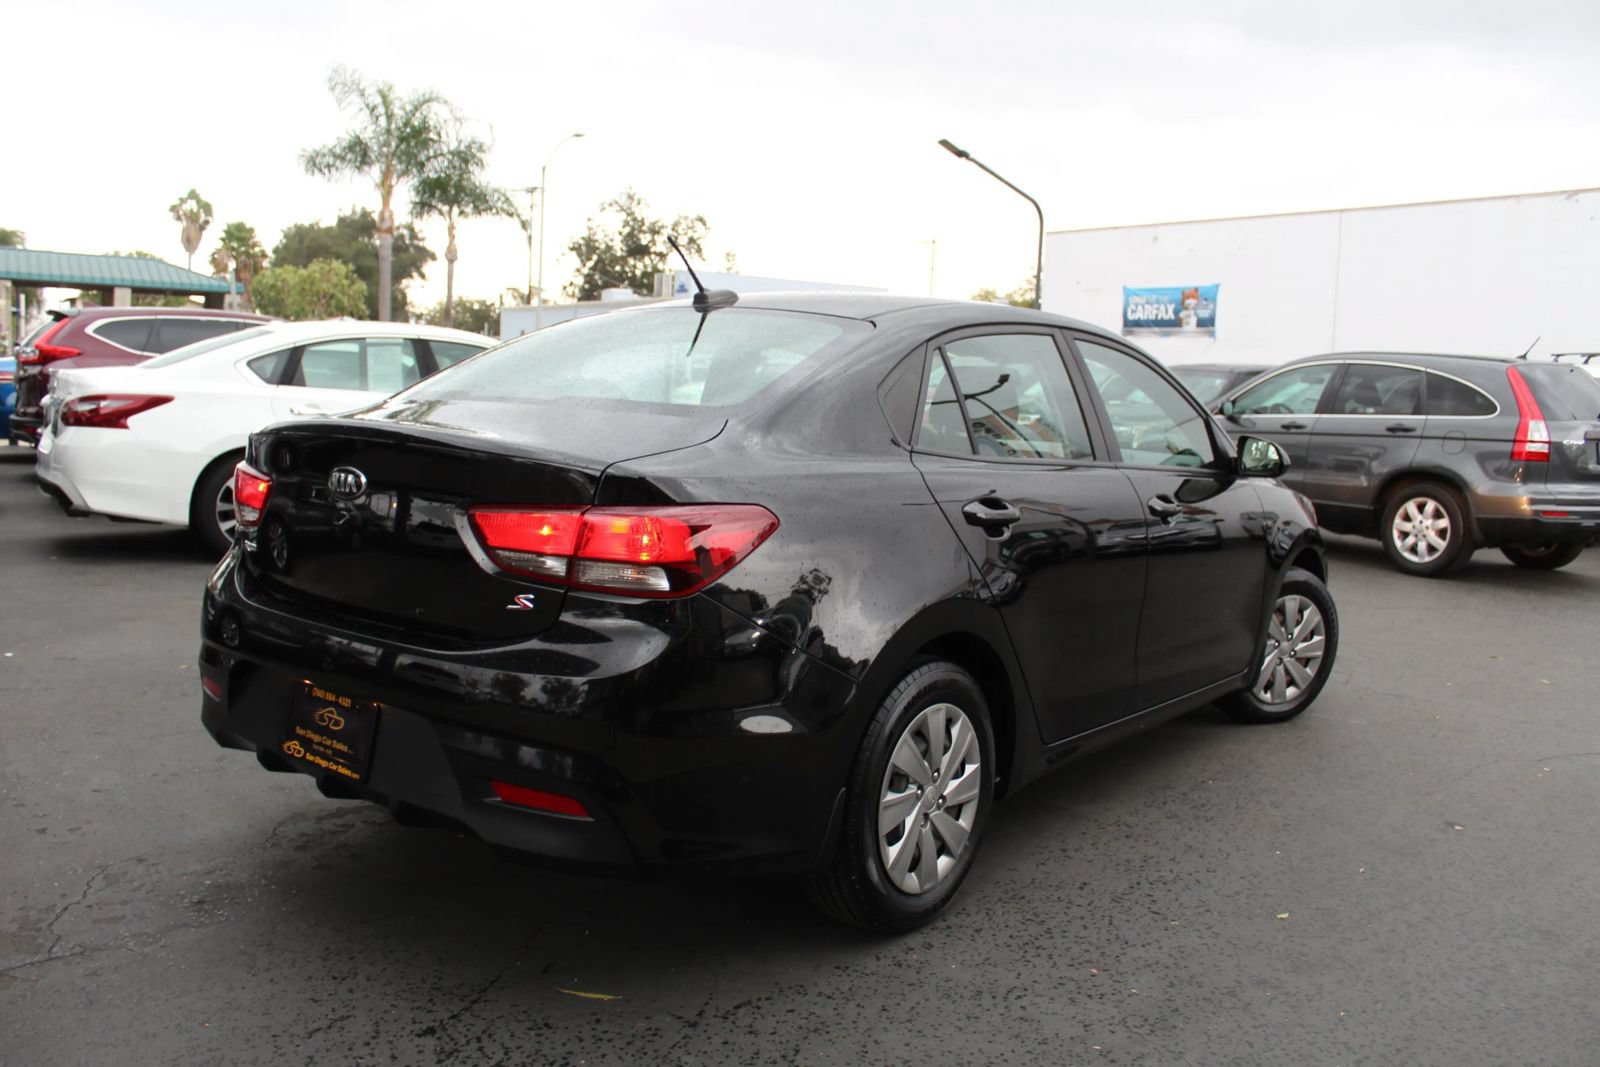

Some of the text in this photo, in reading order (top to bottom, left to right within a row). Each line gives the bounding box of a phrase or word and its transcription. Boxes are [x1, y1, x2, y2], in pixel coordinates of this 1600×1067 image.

[1127, 303, 1175, 320] CARFAX
[332, 472, 358, 493] KIA
[505, 594, 535, 609] S
[295, 726, 306, 736] San
[306, 730, 322, 743] Diego
[322, 736, 332, 746] Car
[305, 752, 315, 762] San
[315, 756, 329, 768] Diego
[328, 762, 338, 771] Car
